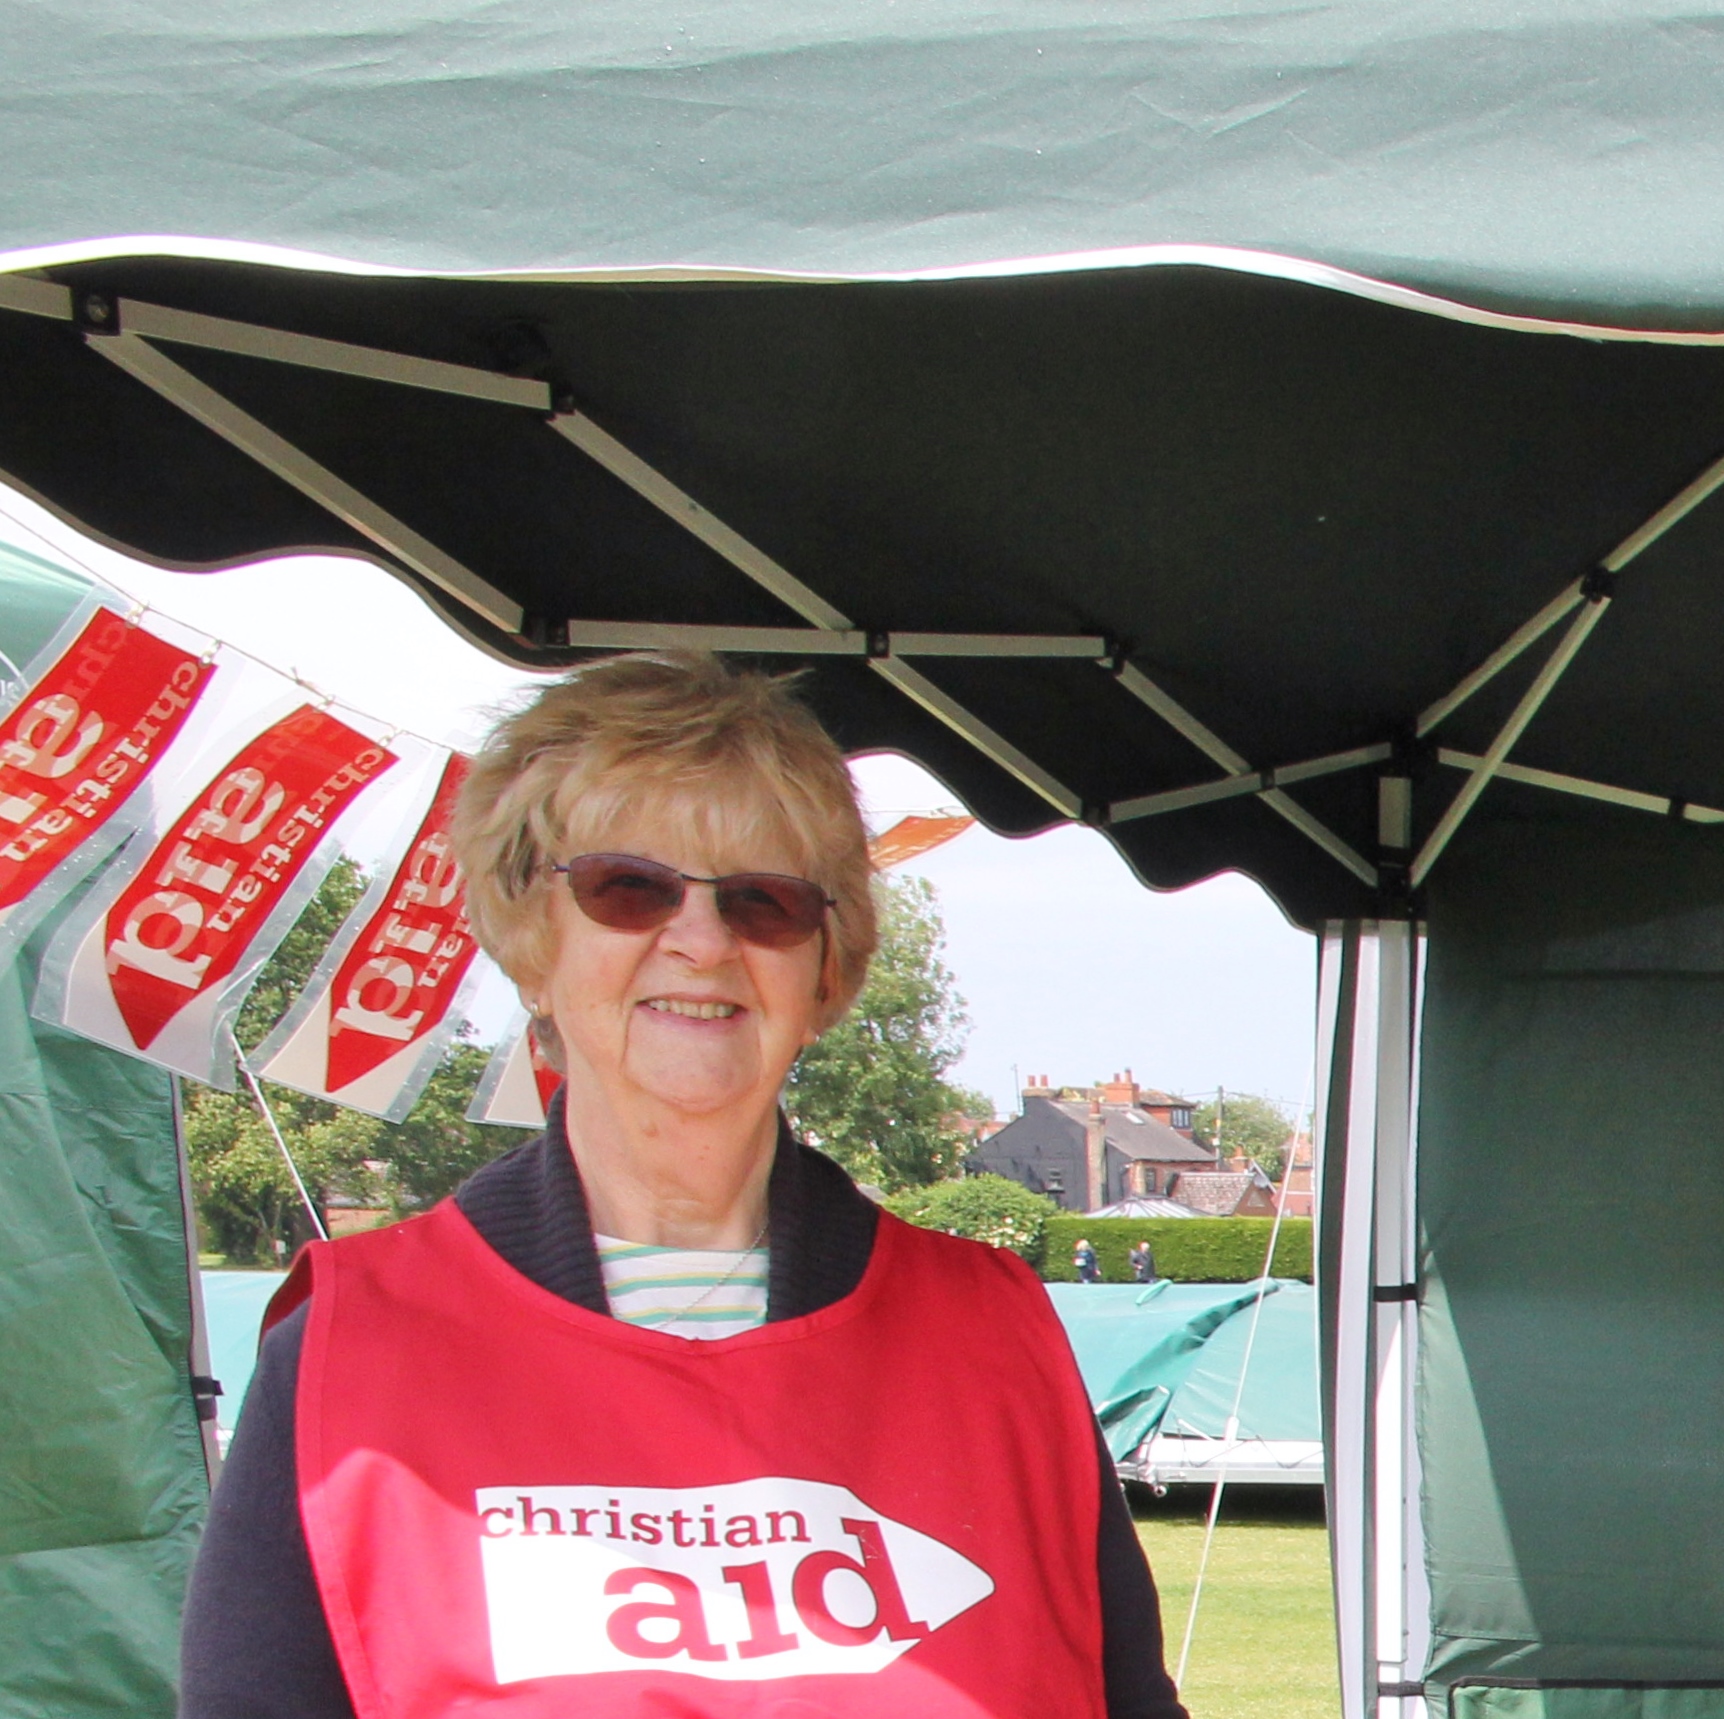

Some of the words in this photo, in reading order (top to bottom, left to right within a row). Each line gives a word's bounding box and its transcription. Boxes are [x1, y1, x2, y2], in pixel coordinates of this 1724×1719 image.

[0, 692, 104, 828] ai
[0, 659, 200, 864] christian
[205, 746, 386, 936] christian
[104, 764, 286, 992] aid
[479, 1494, 812, 1550] christian
[603, 1517, 930, 1663] aid
